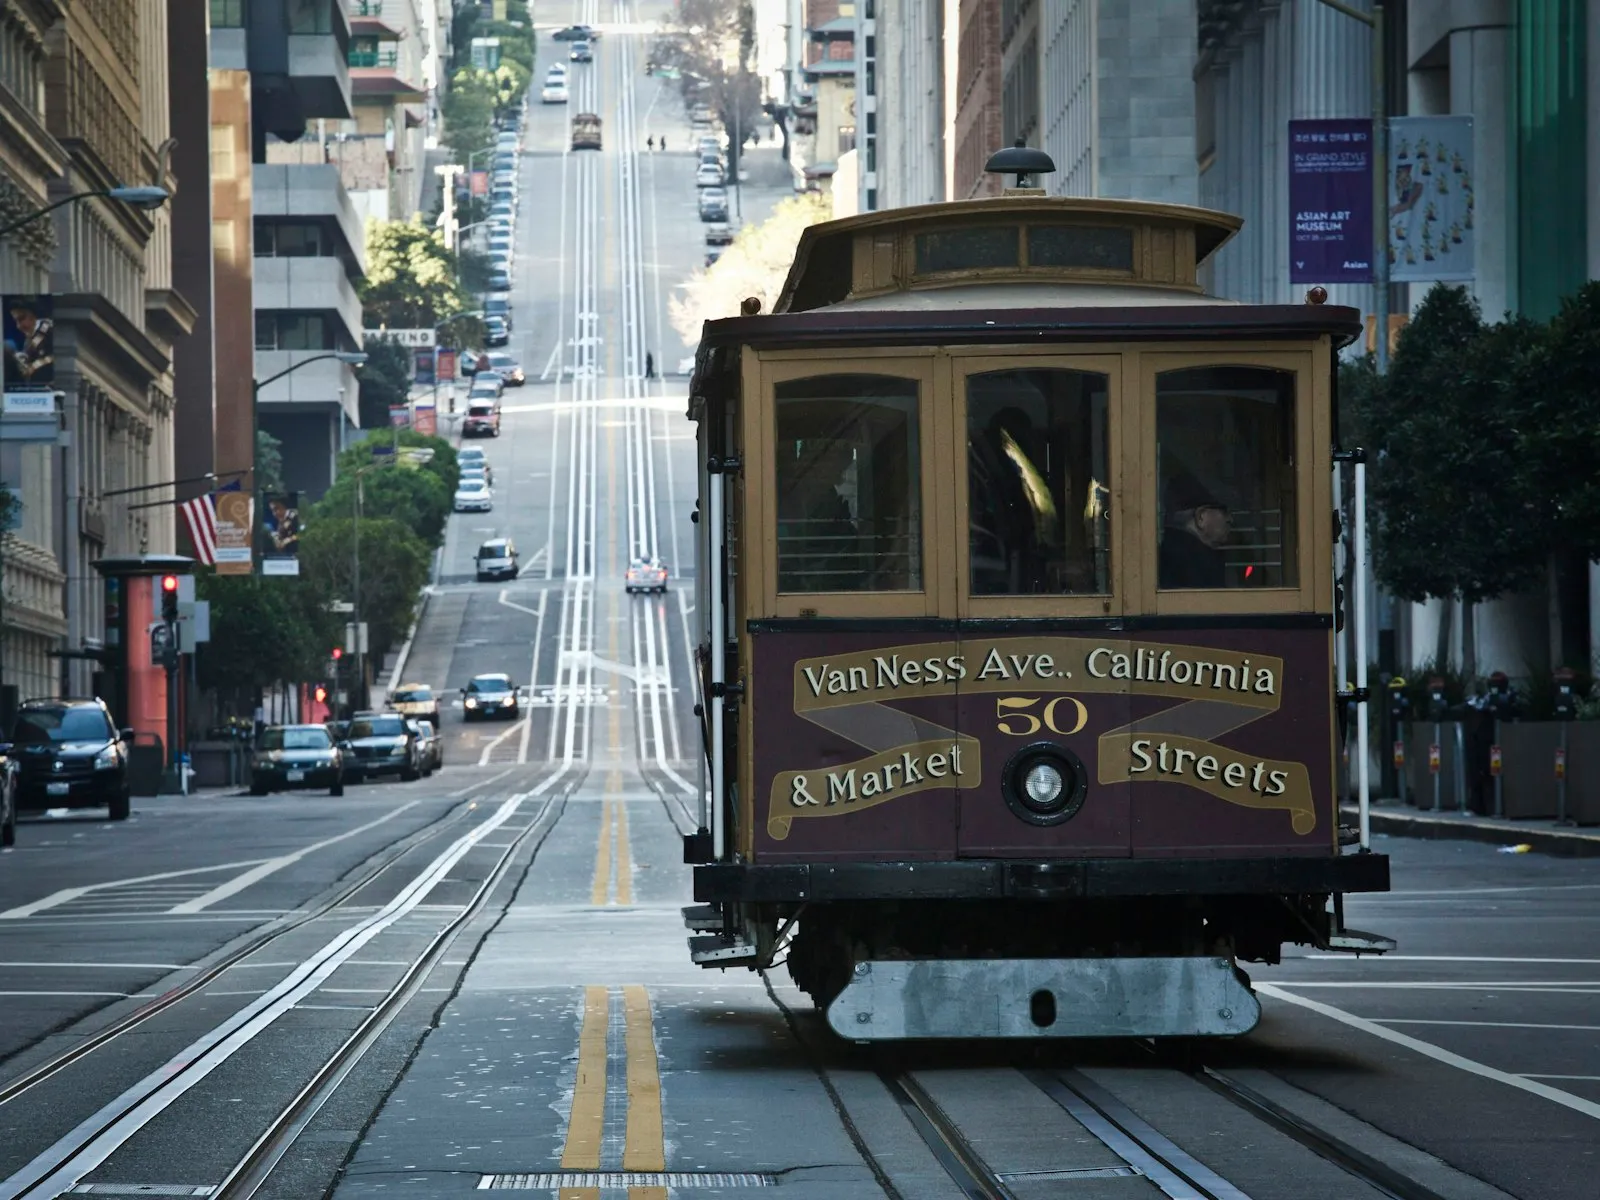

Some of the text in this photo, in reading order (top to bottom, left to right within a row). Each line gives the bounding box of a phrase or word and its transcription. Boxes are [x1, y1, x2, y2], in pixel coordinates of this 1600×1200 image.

[1296, 211, 1351, 221] ASIAN ART
[1296, 222, 1342, 232] MUSEUM
[1343, 261, 1369, 269] Asian
[802, 663, 869, 698] Van
[873, 654, 968, 689] Ness
[1087, 647, 1275, 695] California
[996, 696, 1088, 736] 50
[791, 740, 1289, 807] & Market Streets
